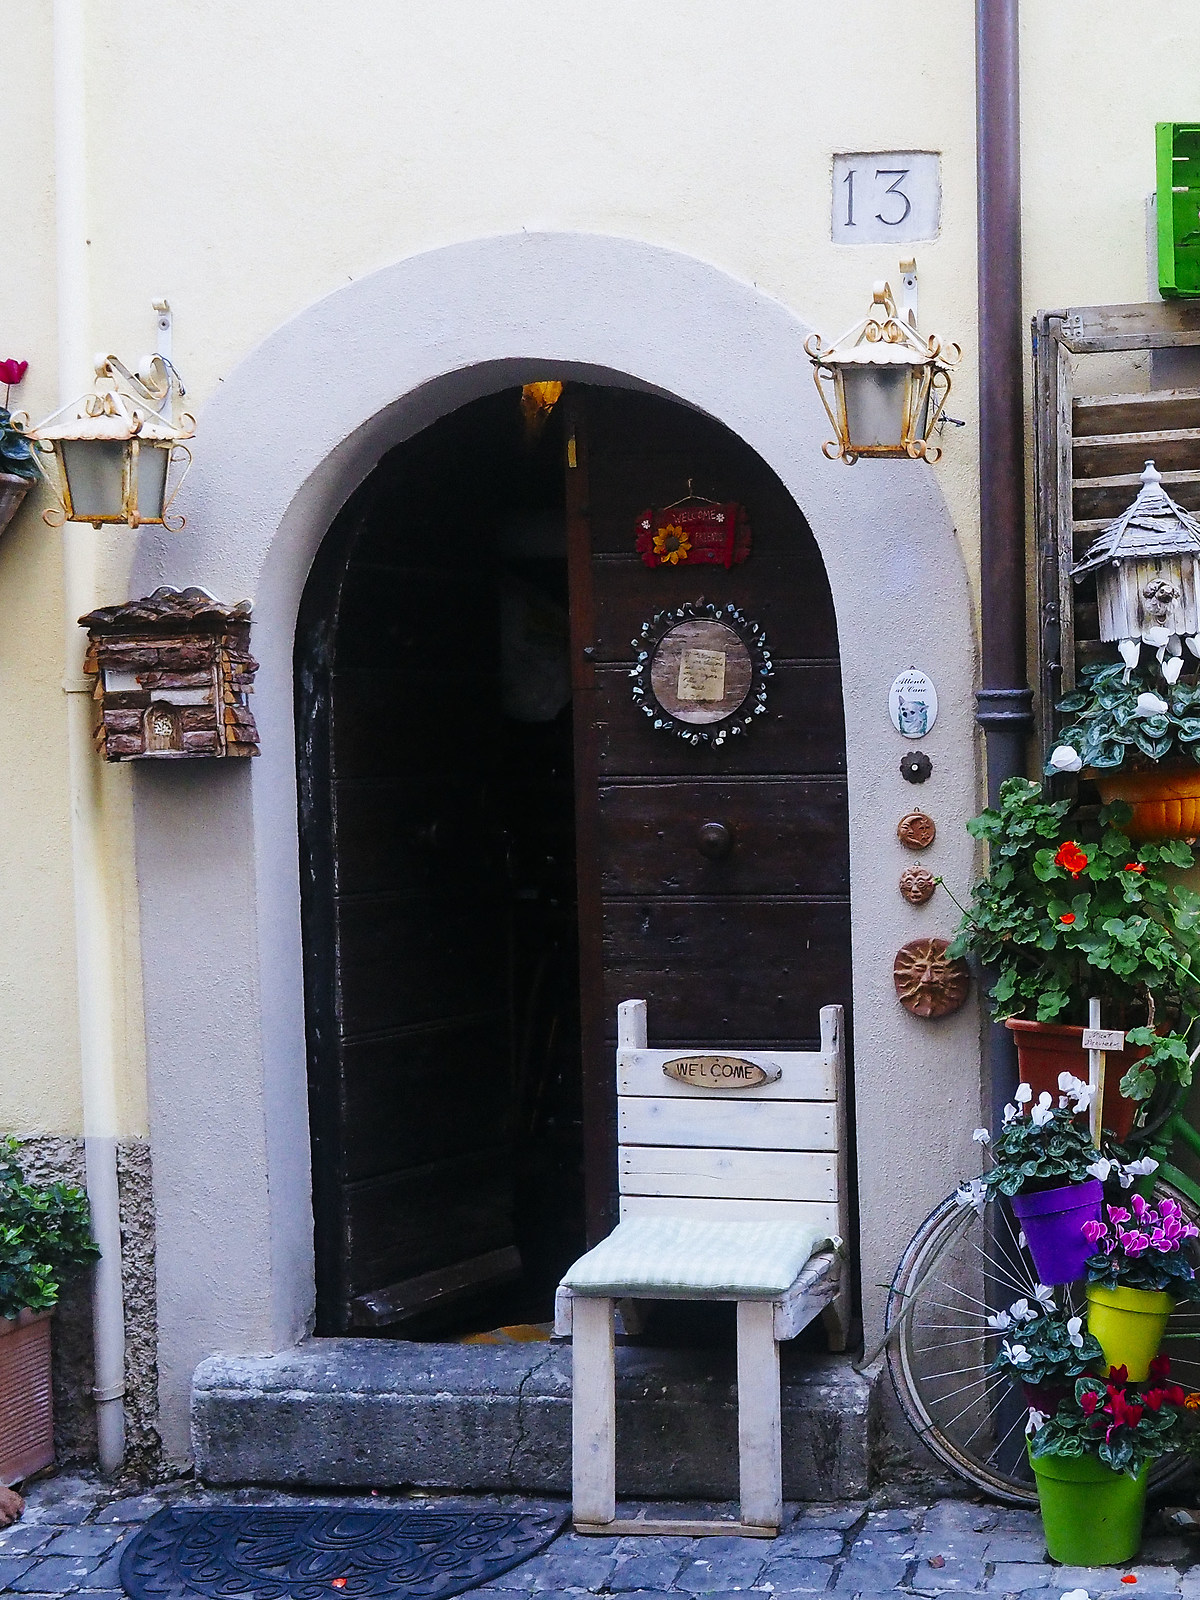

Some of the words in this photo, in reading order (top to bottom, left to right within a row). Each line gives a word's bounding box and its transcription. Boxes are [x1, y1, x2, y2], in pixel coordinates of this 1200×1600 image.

[842, 168, 911, 226] 13
[672, 509, 717, 524] WELCOME
[676, 1063, 755, 1080] WELCOME
